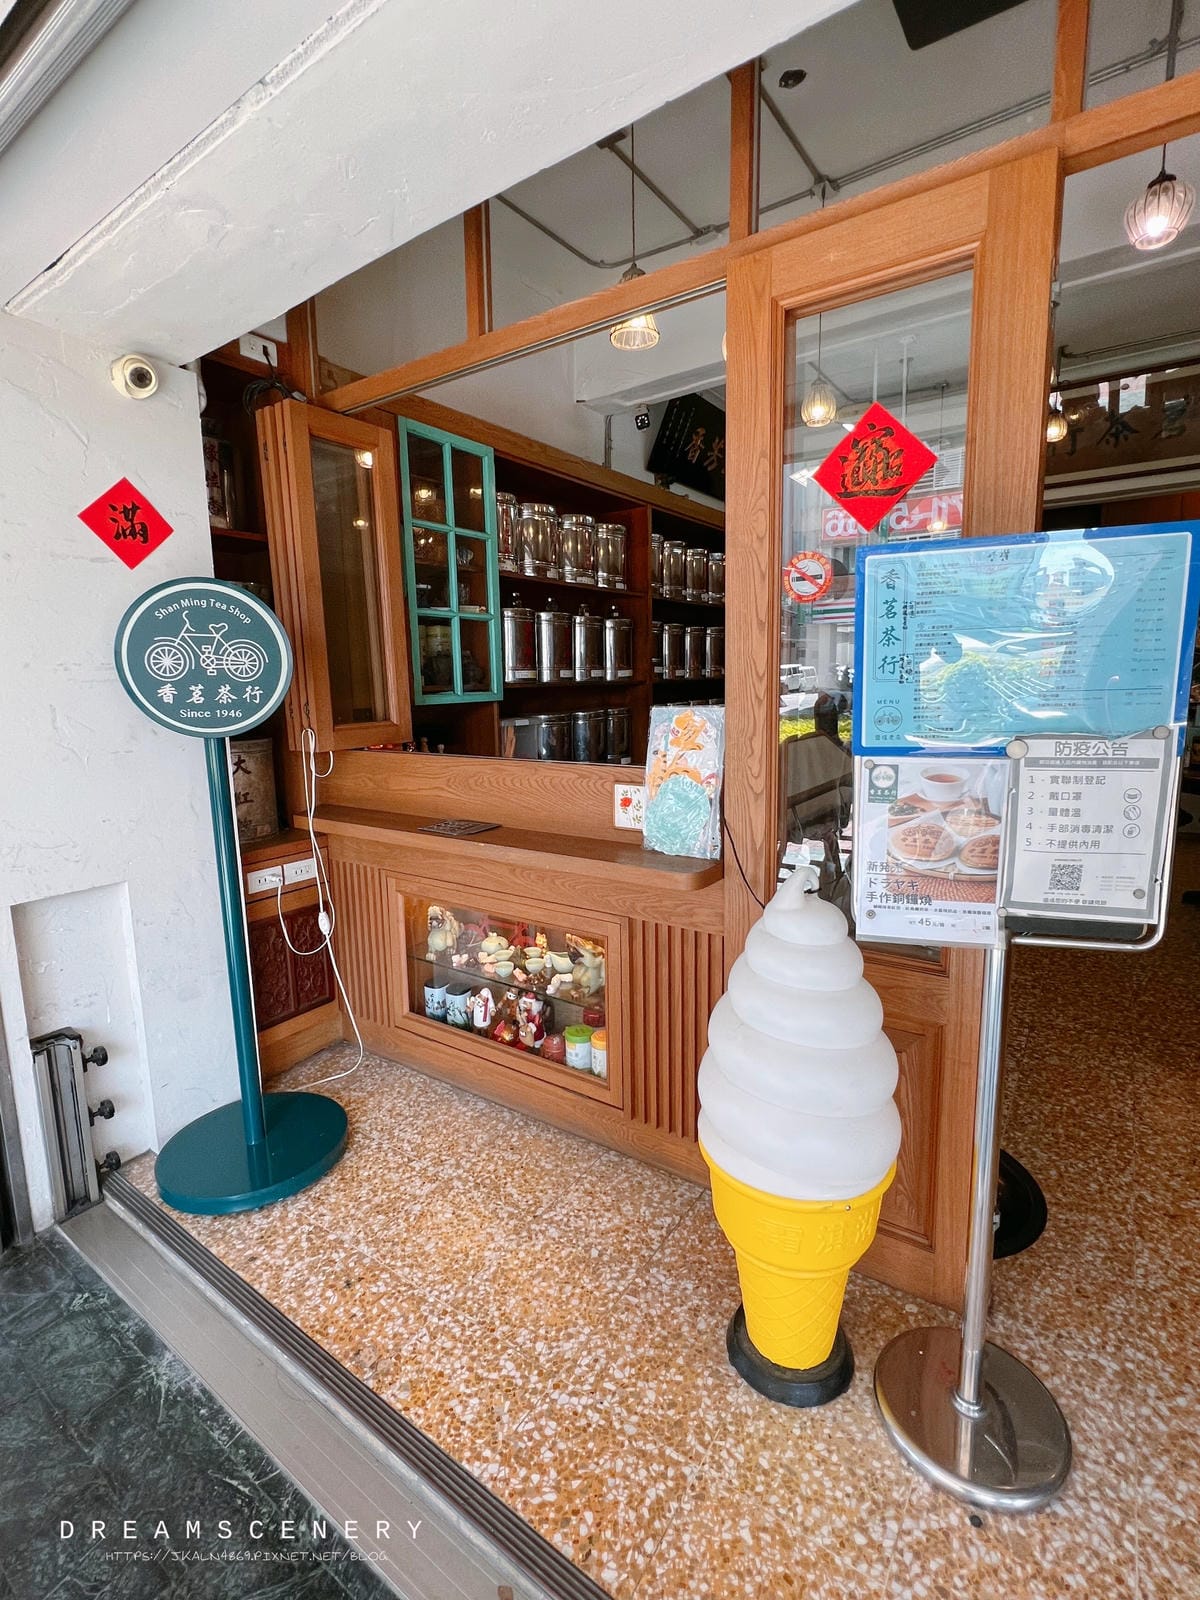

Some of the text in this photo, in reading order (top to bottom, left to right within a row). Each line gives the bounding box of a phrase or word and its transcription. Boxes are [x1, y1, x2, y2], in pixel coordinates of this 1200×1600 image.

[109, 501, 149, 544] 滿
[154, 598, 252, 624] Shan Ming Tea Shop
[878, 568, 902, 675] 香茗茶行
[157, 683, 263, 704] 香茗茶行
[180, 709, 242, 719] Since 1946
[1054, 741, 1129, 757] 防疫公告
[868, 877, 919, 891] ドラヤキ
[917, 917, 932, 927] 45
